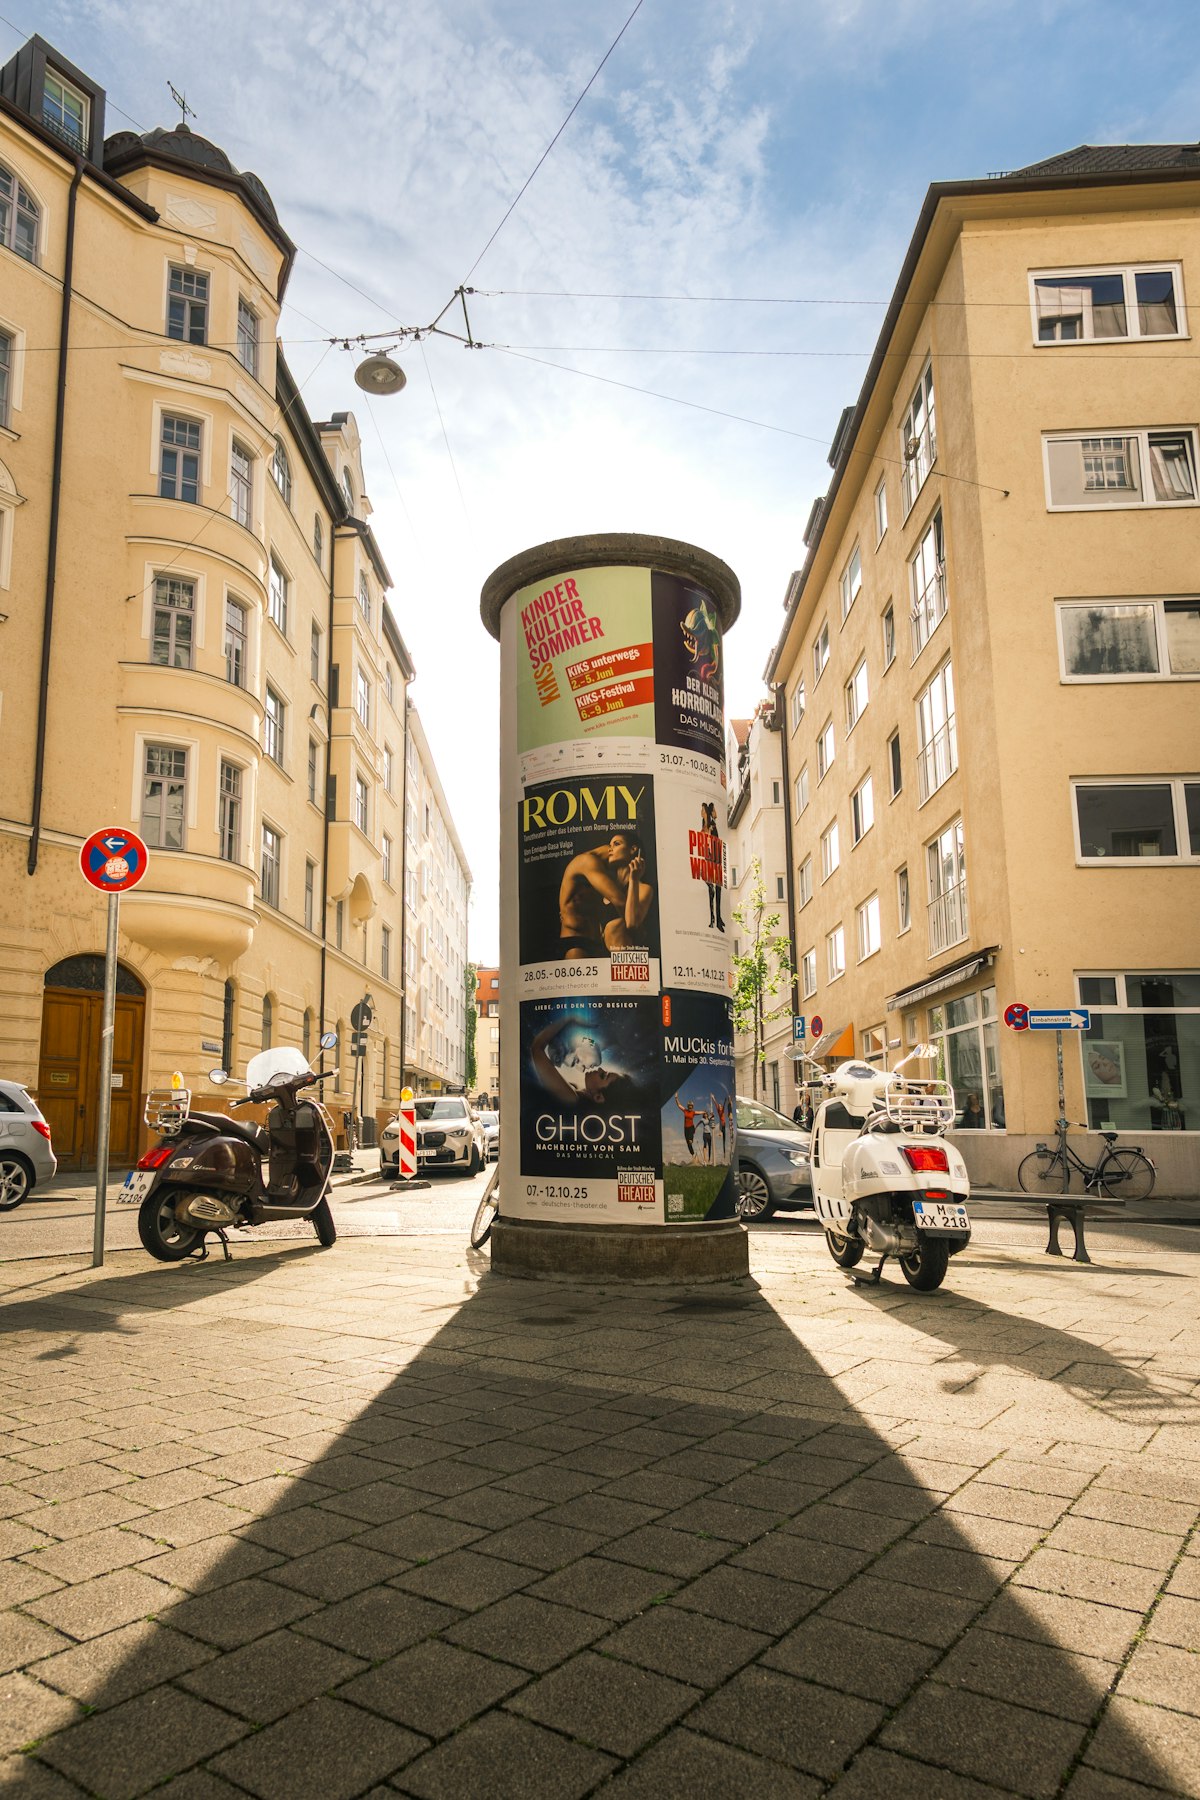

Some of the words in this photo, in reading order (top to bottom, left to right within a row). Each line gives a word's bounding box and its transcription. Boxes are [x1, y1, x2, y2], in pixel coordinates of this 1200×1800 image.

[521, 578, 579, 630] KINDER
[525, 599, 586, 650] KULTUR
[529, 616, 605, 669] SOMMER
[591, 648, 640, 669] unterwegs
[596, 666, 614, 681] Juni
[686, 676, 700, 693] DER
[606, 698, 625, 712] Juni
[680, 713, 698, 728] DAS
[523, 786, 645, 832] ROMY
[567, 825, 582, 834] Leben
[593, 823, 609, 832] Romy
[609, 822, 637, 831] Schneider
[612, 952, 648, 964] DEUTSCHES
[612, 965, 649, 980] THEATER
[795, 1019, 803, 1037] P
[664, 1036, 715, 1055] MUCkis
[718, 1040, 728, 1056] for
[665, 1055, 671, 1063] 1.
[672, 1054, 687, 1064] Mai
[688, 1055, 699, 1064] bis
[699, 1056, 708, 1065] 30.
[536, 1114, 641, 1142] GHOST
[536, 1143, 588, 1151] NACHRICHT
[593, 1144, 614, 1152] VON
[619, 1173, 654, 1185] DEUTSCHES
[619, 1185, 655, 1201] THEATER
[541, 1200, 608, 1210] deutsches-theater.de
[936, 1204, 946, 1216] M
[919, 1215, 937, 1227] XX
[942, 1216, 967, 1228] 218
